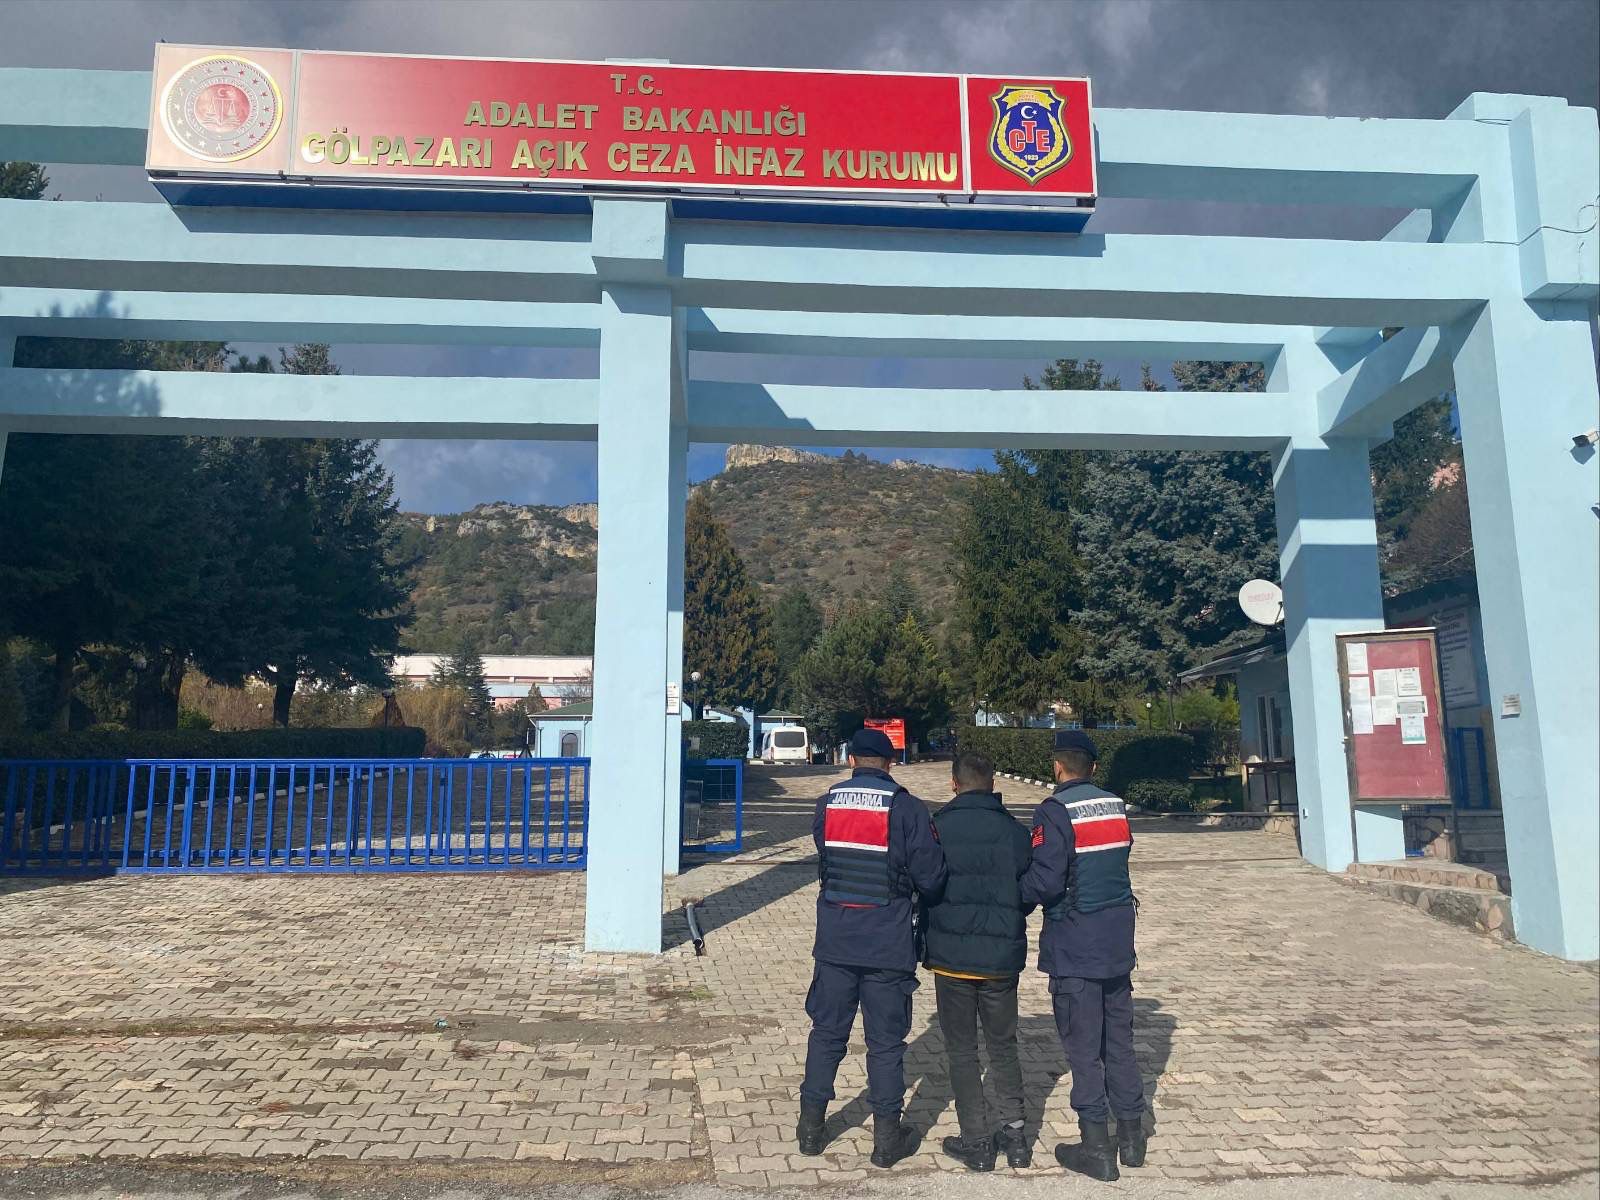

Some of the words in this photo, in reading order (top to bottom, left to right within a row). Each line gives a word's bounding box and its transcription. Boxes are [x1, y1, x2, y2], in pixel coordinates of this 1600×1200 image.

[610, 73, 664, 96] T.C.
[463, 100, 599, 130] ADALET
[622, 105, 807, 137] BAKANLIĞI
[1008, 120, 1051, 153] CTE
[300, 126, 494, 169] GÖLPAZARI
[510, 138, 589, 178] AÇIK
[607, 142, 696, 174] CEZA
[714, 138, 806, 179] İNFAZ
[822, 149, 959, 183] KURUMU
[832, 792, 883, 807] JANDARMA
[1075, 801, 1120, 819] JANDARMA
